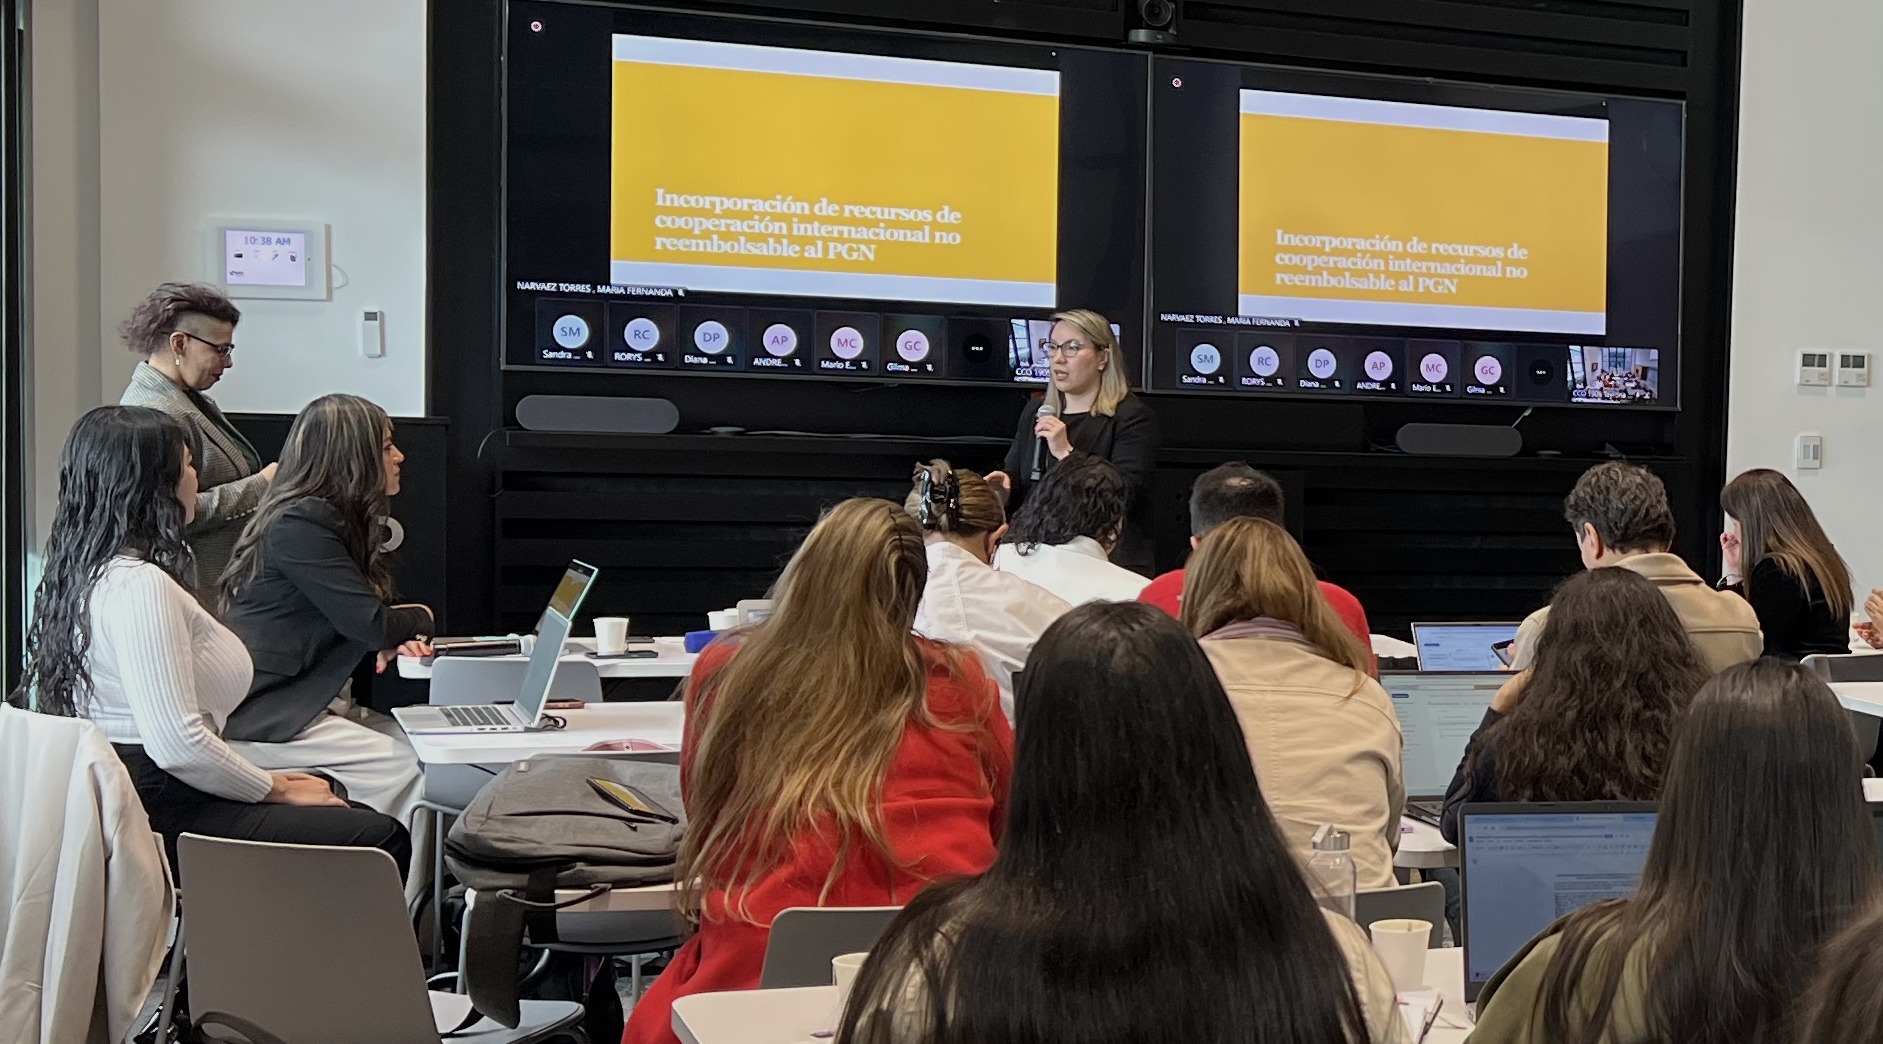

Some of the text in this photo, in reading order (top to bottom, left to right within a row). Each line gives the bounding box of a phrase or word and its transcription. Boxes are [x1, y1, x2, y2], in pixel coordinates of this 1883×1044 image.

[655, 188, 962, 224] Incorporación de recursos de
[655, 214, 961, 245] cooperación internacional no
[275, 237, 291, 246] AM
[1275, 229, 1528, 260] Incorporación de recursos de
[655, 235, 876, 260] reembolsable al PGN
[1275, 251, 1528, 279] cooperación internacional no
[1275, 271, 1458, 294] reembolsable al PGN
[517, 281, 557, 292] NARVAEZ
[559, 283, 591, 293] TORRES
[627, 286, 673, 297] FERNANDA
[560, 326, 581, 338] SM
[633, 329, 650, 340] RC
[703, 332, 720, 343] DP
[771, 335, 788, 346] AP
[837, 337, 857, 349] MC
[904, 340, 921, 351] GC
[542, 350, 572, 360] Sandra
[684, 354, 708, 364] Diana
[1197, 354, 1214, 364] SM
[1257, 356, 1272, 366] RC
[1315, 359, 1330, 369] DP
[1371, 361, 1386, 371] AP
[1425, 364, 1442, 374] MC
[1480, 365, 1495, 375] GC
[1181, 375, 1207, 385] Sandra
